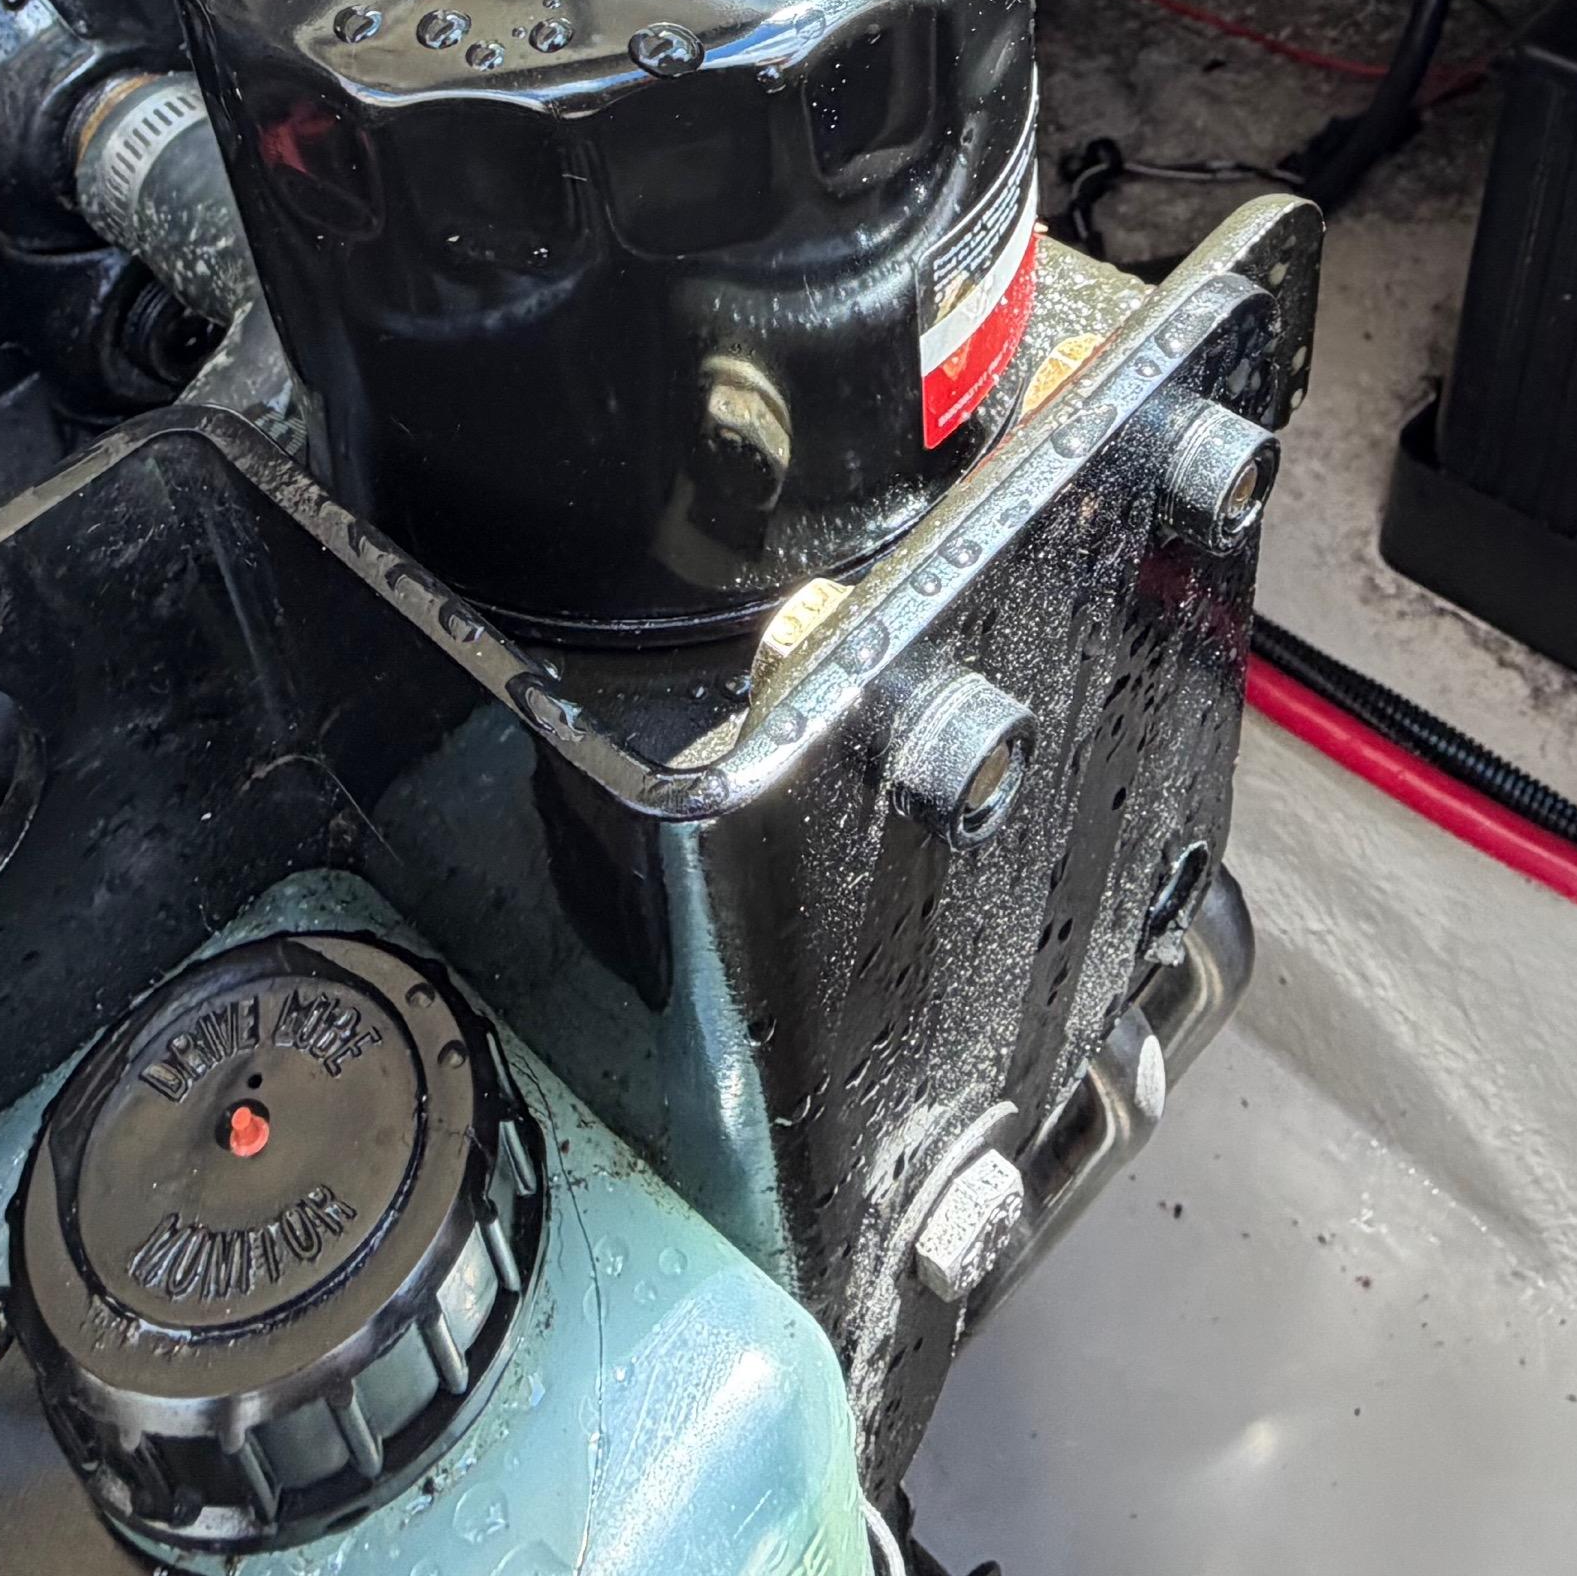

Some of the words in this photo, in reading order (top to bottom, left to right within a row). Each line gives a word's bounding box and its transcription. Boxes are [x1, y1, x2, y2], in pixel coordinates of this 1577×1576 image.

[139, 994, 261, 1103] DRIVE
[272, 989, 383, 1079] LUBE
[127, 1182, 358, 1302] MONITOR
